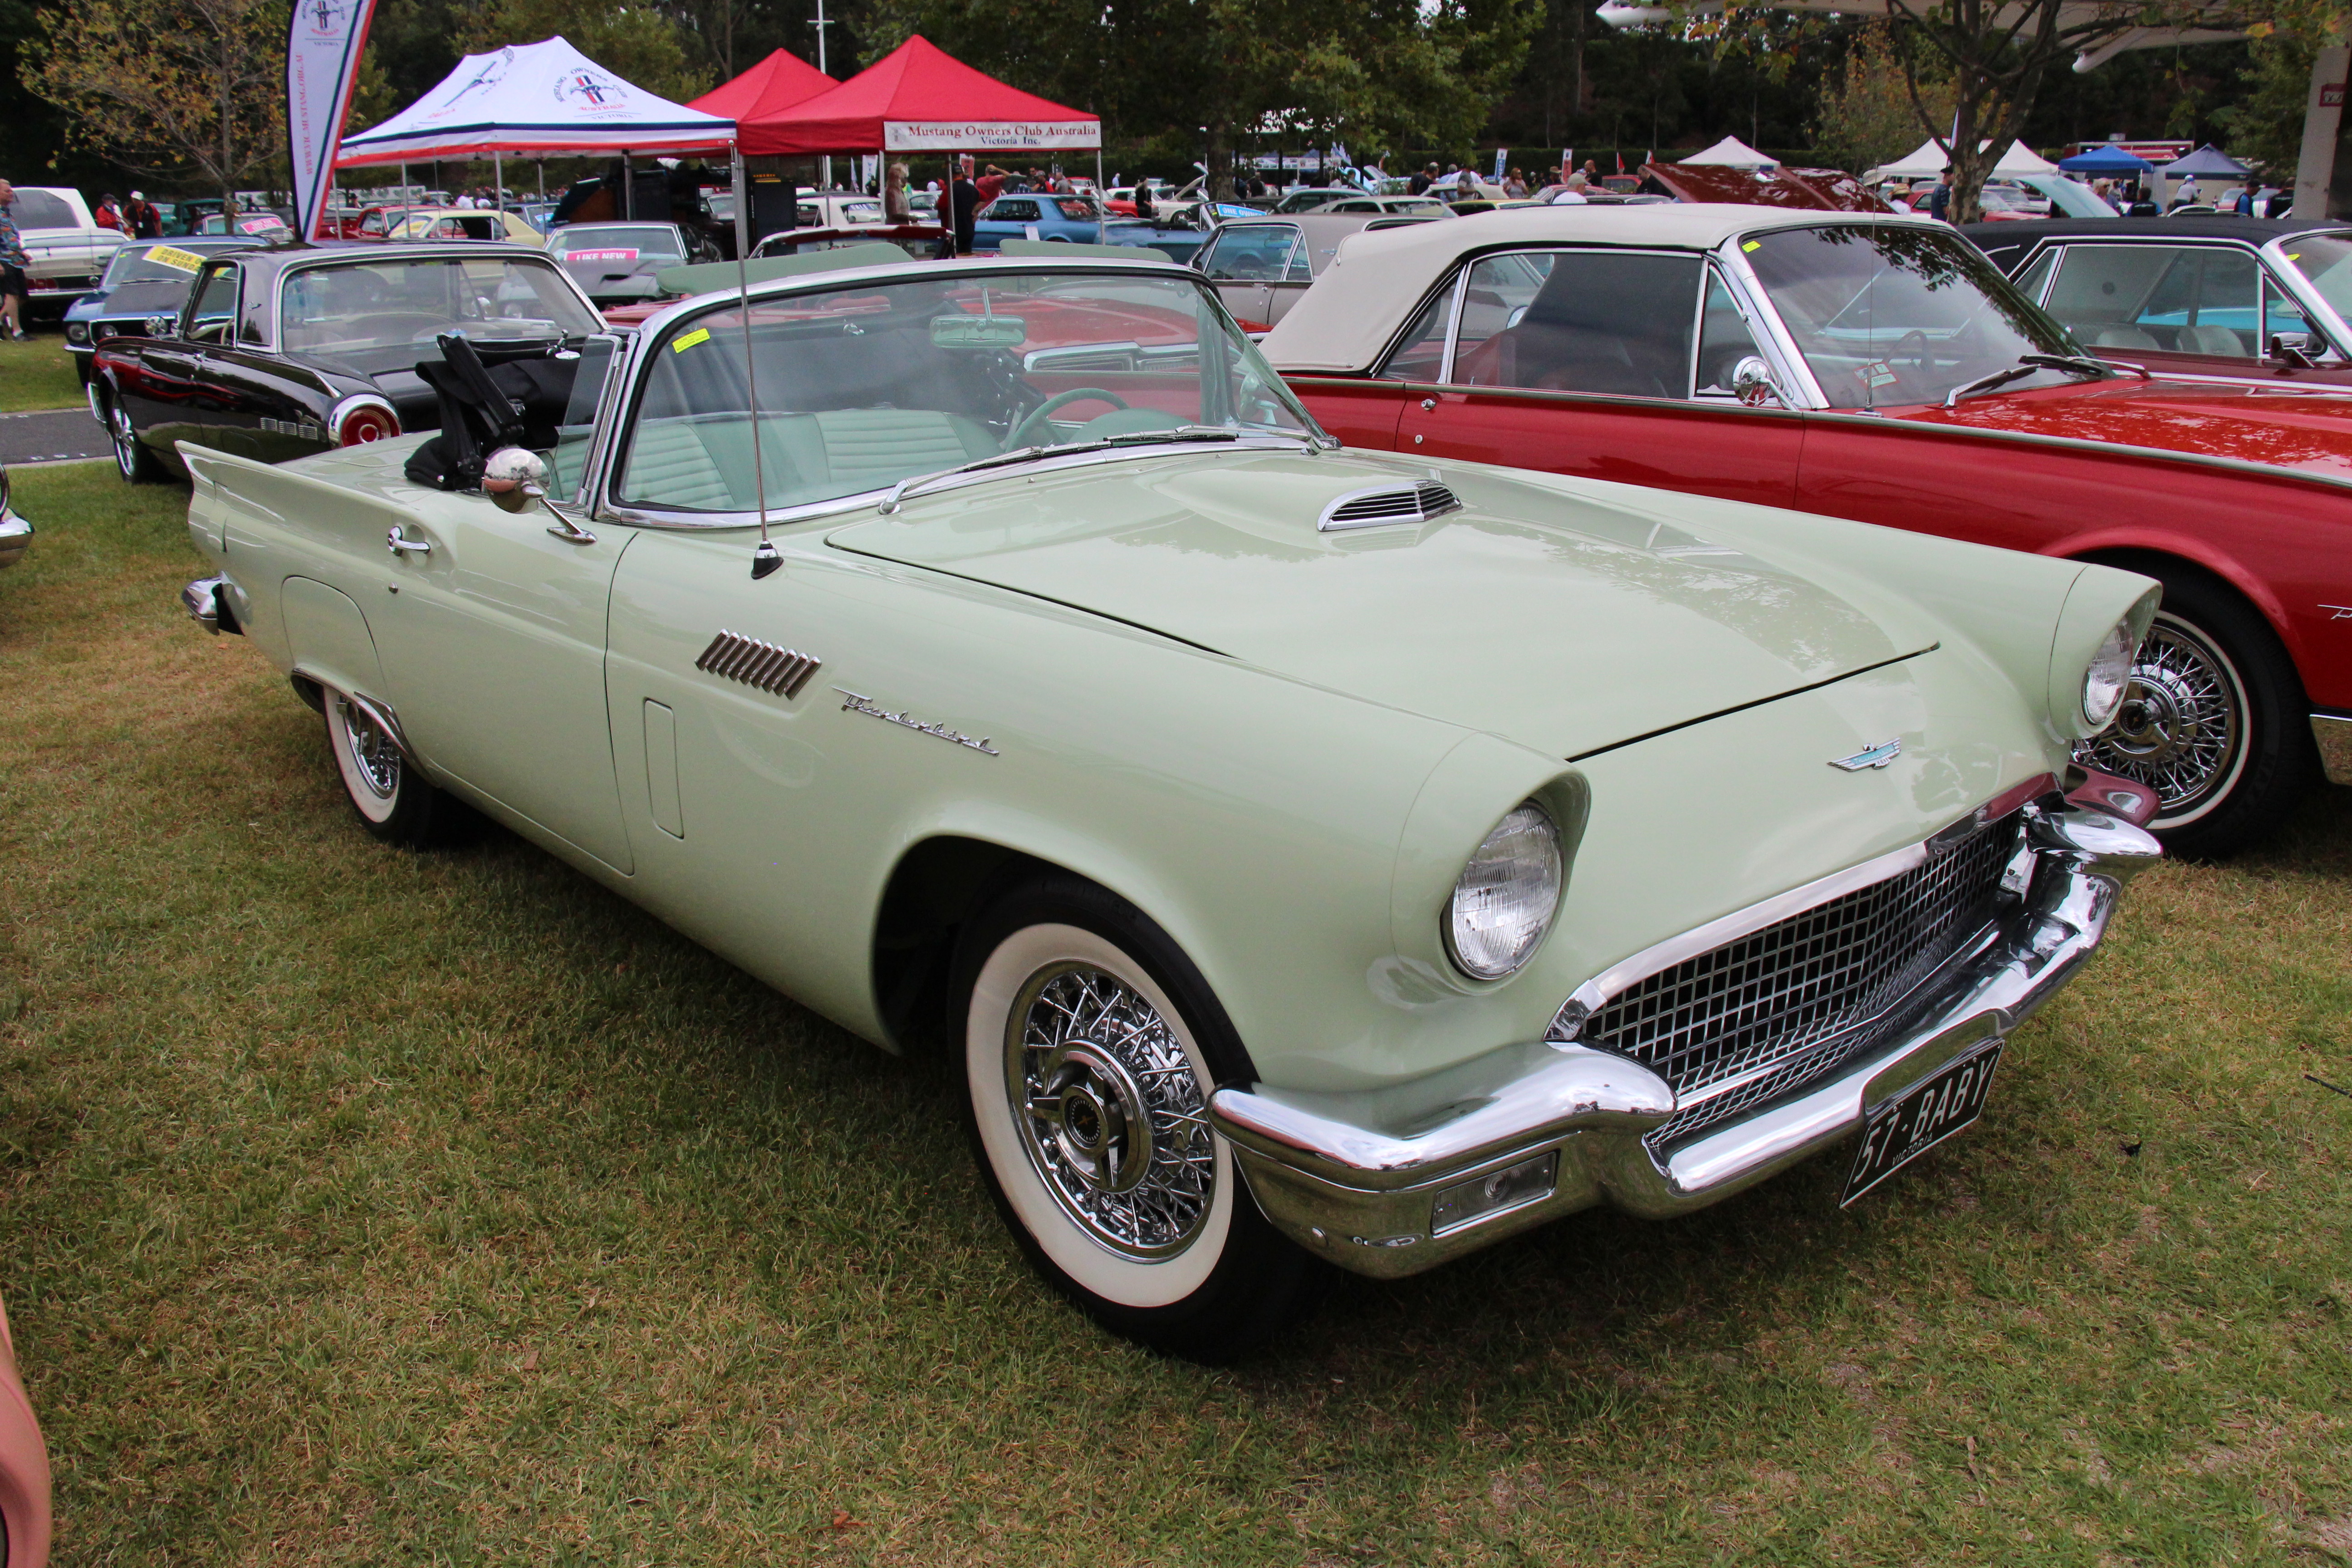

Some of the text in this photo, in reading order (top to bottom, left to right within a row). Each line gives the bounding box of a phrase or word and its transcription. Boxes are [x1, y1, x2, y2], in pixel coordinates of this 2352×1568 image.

[554, 76, 567, 103] MUSTANG
[570, 67, 608, 82] OWNERS
[908, 125, 1096, 138] Mustang Owners Club Australia
[161, 249, 193, 261] DRIVEN
[170, 259, 201, 272] SUNDA
[831, 686, 999, 756] Thunderbird
[1892, 1132, 1933, 1167] VICTORIA
